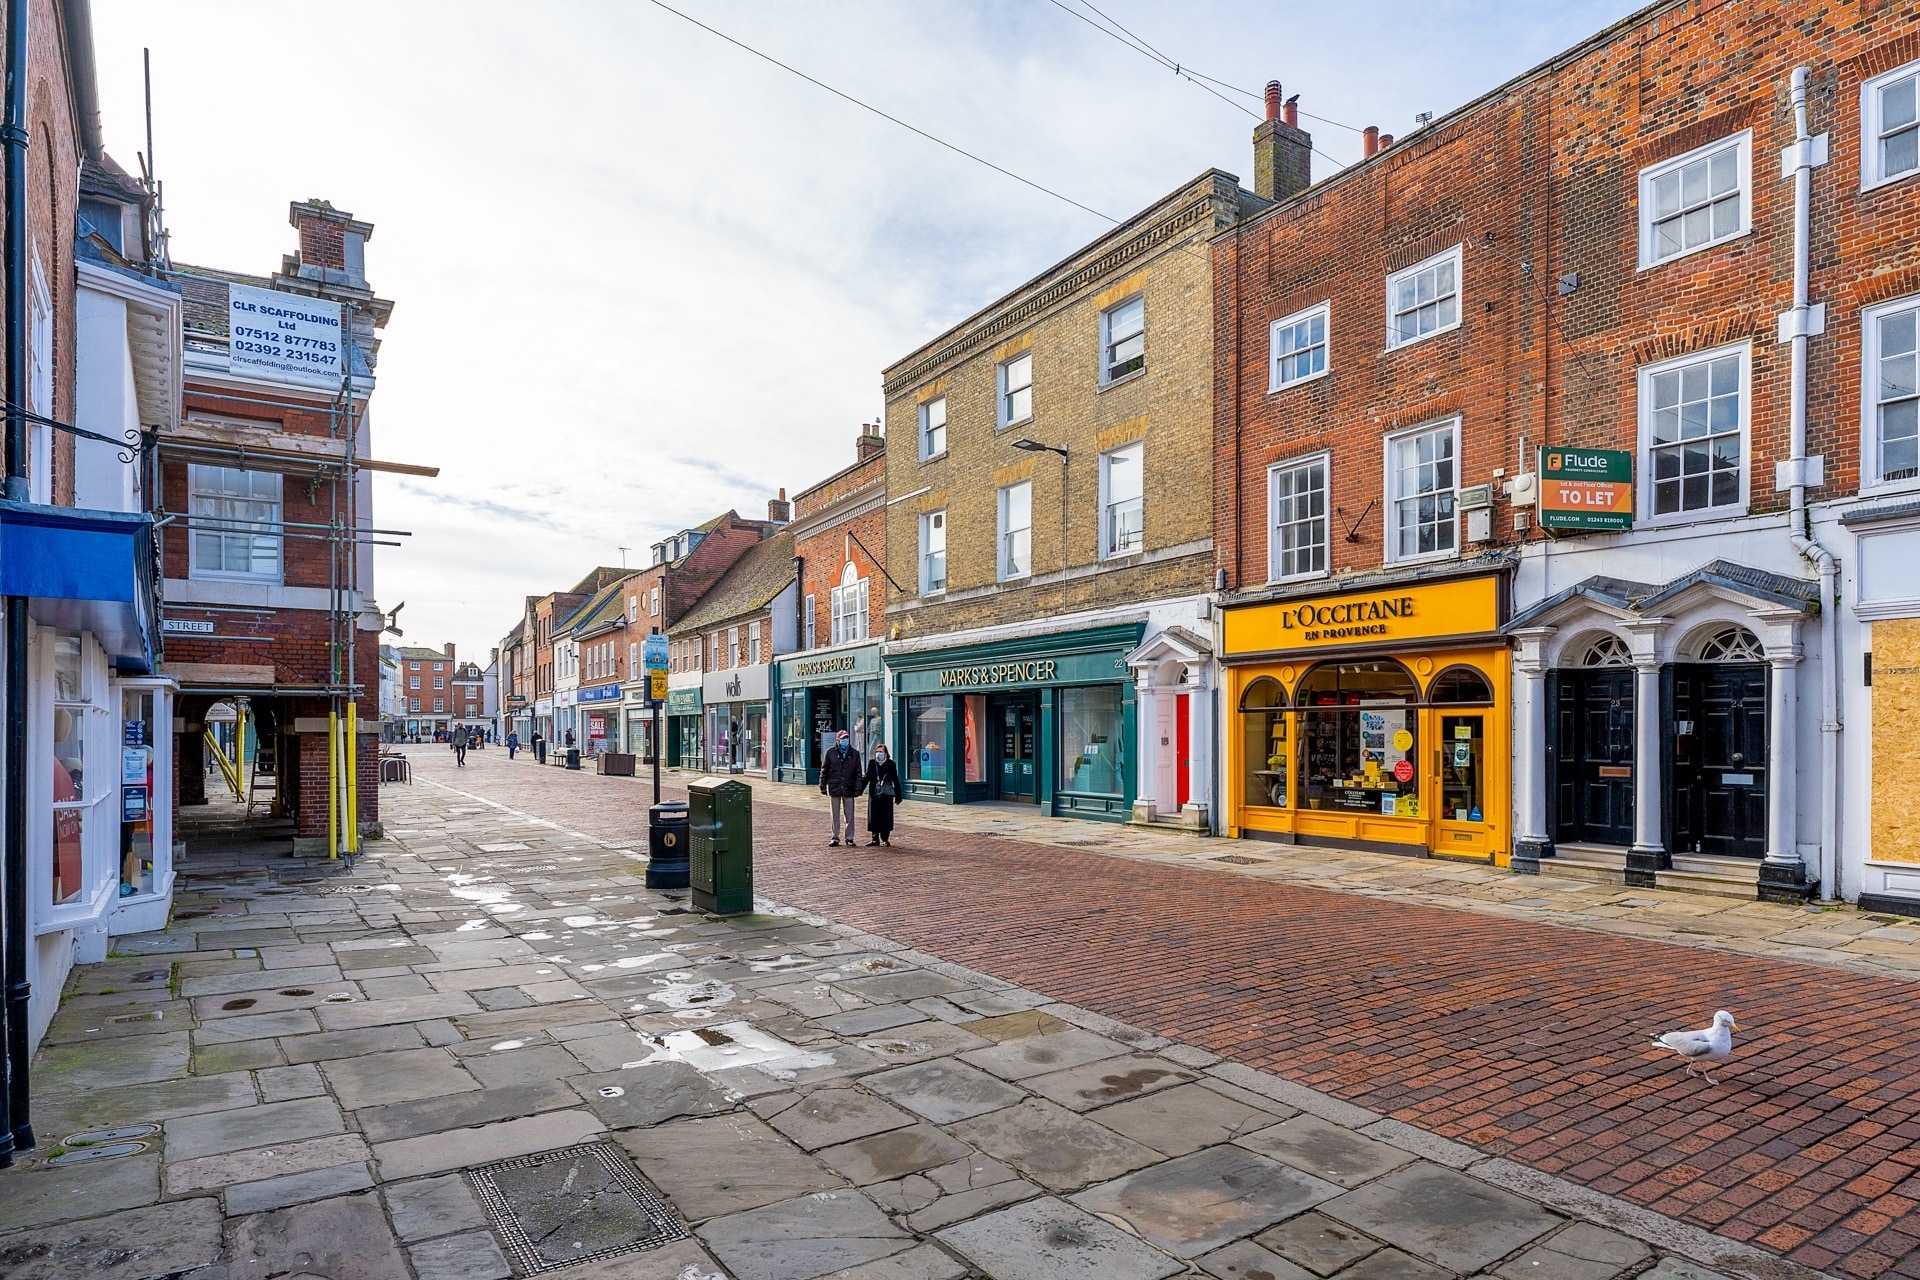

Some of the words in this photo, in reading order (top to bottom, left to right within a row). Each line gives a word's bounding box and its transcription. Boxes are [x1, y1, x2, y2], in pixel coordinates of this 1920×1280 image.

[233, 301, 256, 312] CLR
[260, 305, 339, 327] SCAFFOLDING
[278, 321, 296, 331] Ltd
[235, 326, 279, 342] 07512
[284, 335, 337, 352] 877783
[235, 340, 280, 356] 02392
[286, 349, 337, 365] 231547
[232, 355, 339, 377] clrscaffolding@outlook.com
[1565, 454, 1607, 468] Flude
[1560, 489, 1582, 504] TO
[1586, 491, 1614, 506] LET
[168, 621, 211, 631] STREET
[1304, 631, 1319, 640] EN
[1323, 624, 1387, 638] PROVENCE
[797, 661, 818, 676] MARKS
[822, 656, 855, 672] SPENCER
[1114, 659, 1123, 668] 22
[940, 667, 979, 687] MARKS
[980, 667, 989, 684] &
[991, 660, 1056, 683] SPENCER
[1731, 700, 1743, 708] 24
[590, 721, 605, 730] SALE
